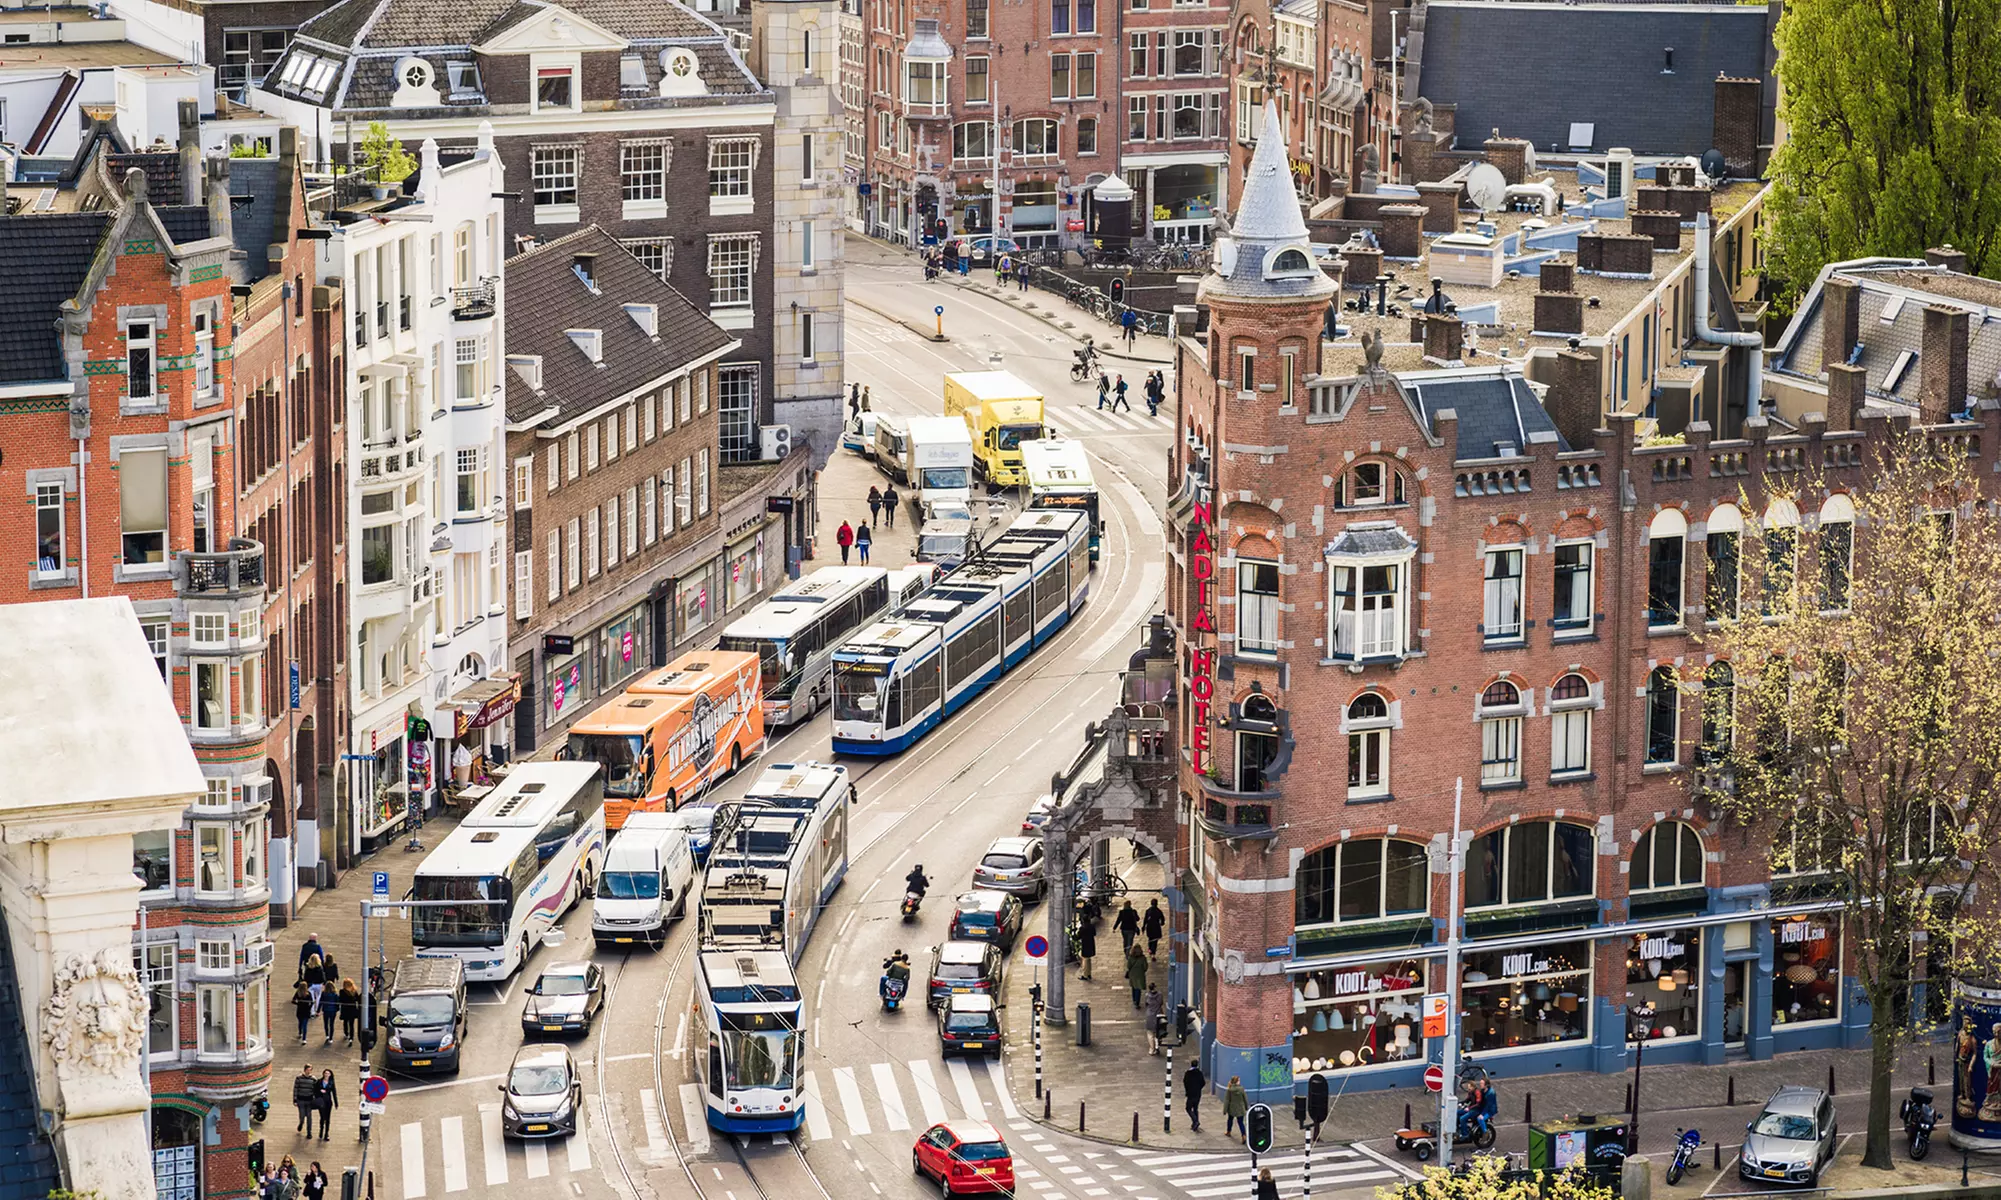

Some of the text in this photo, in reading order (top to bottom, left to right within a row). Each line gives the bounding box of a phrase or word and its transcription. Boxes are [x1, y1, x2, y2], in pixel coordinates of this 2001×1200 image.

[1191, 501, 1213, 775] NADIA HOTEL
[376, 874, 385, 886] P
